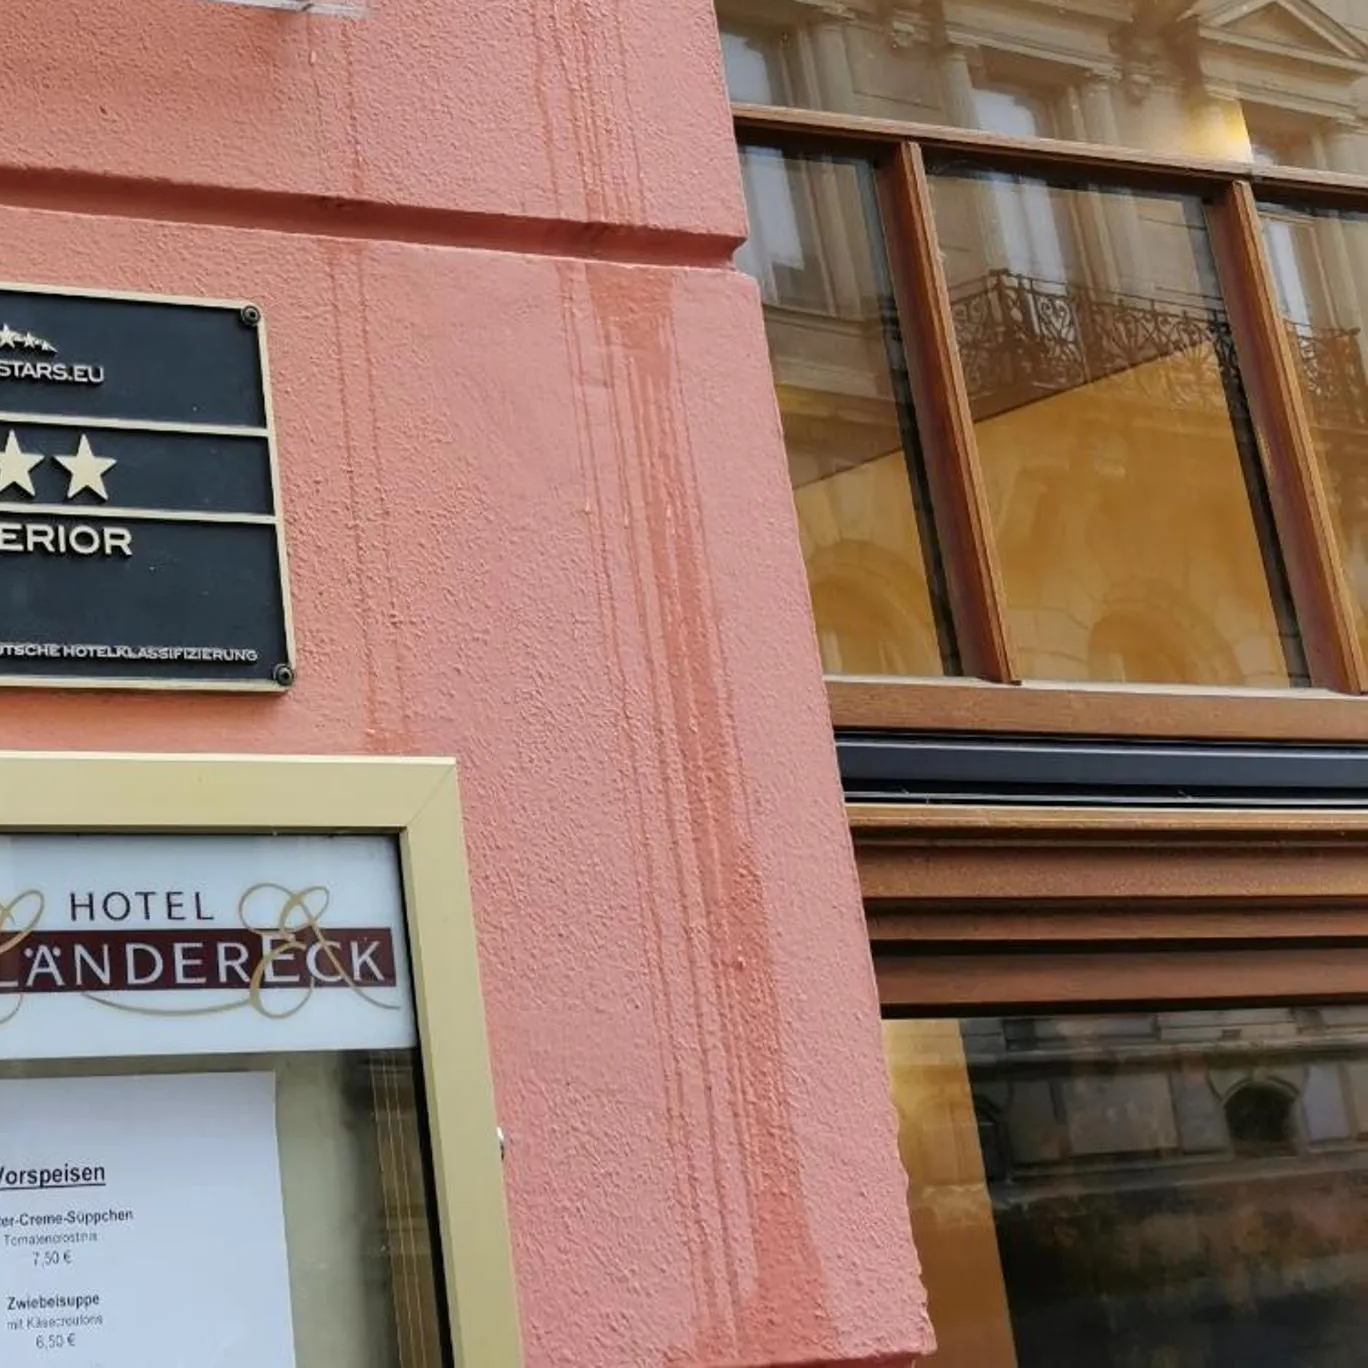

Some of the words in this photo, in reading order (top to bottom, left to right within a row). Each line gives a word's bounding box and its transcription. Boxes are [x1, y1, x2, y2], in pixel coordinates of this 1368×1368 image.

[62, 643, 259, 662] HOTELKLASSIFIZIERUNG
[69, 890, 215, 922] HOTEL
[63, 1249, 72, 1264] €
[7, 1293, 100, 1311] Zwiebelsuppe
[7, 1317, 23, 1331] mit
[35, 1334, 65, 1351] 6,50
[67, 1333, 76, 1347] €
